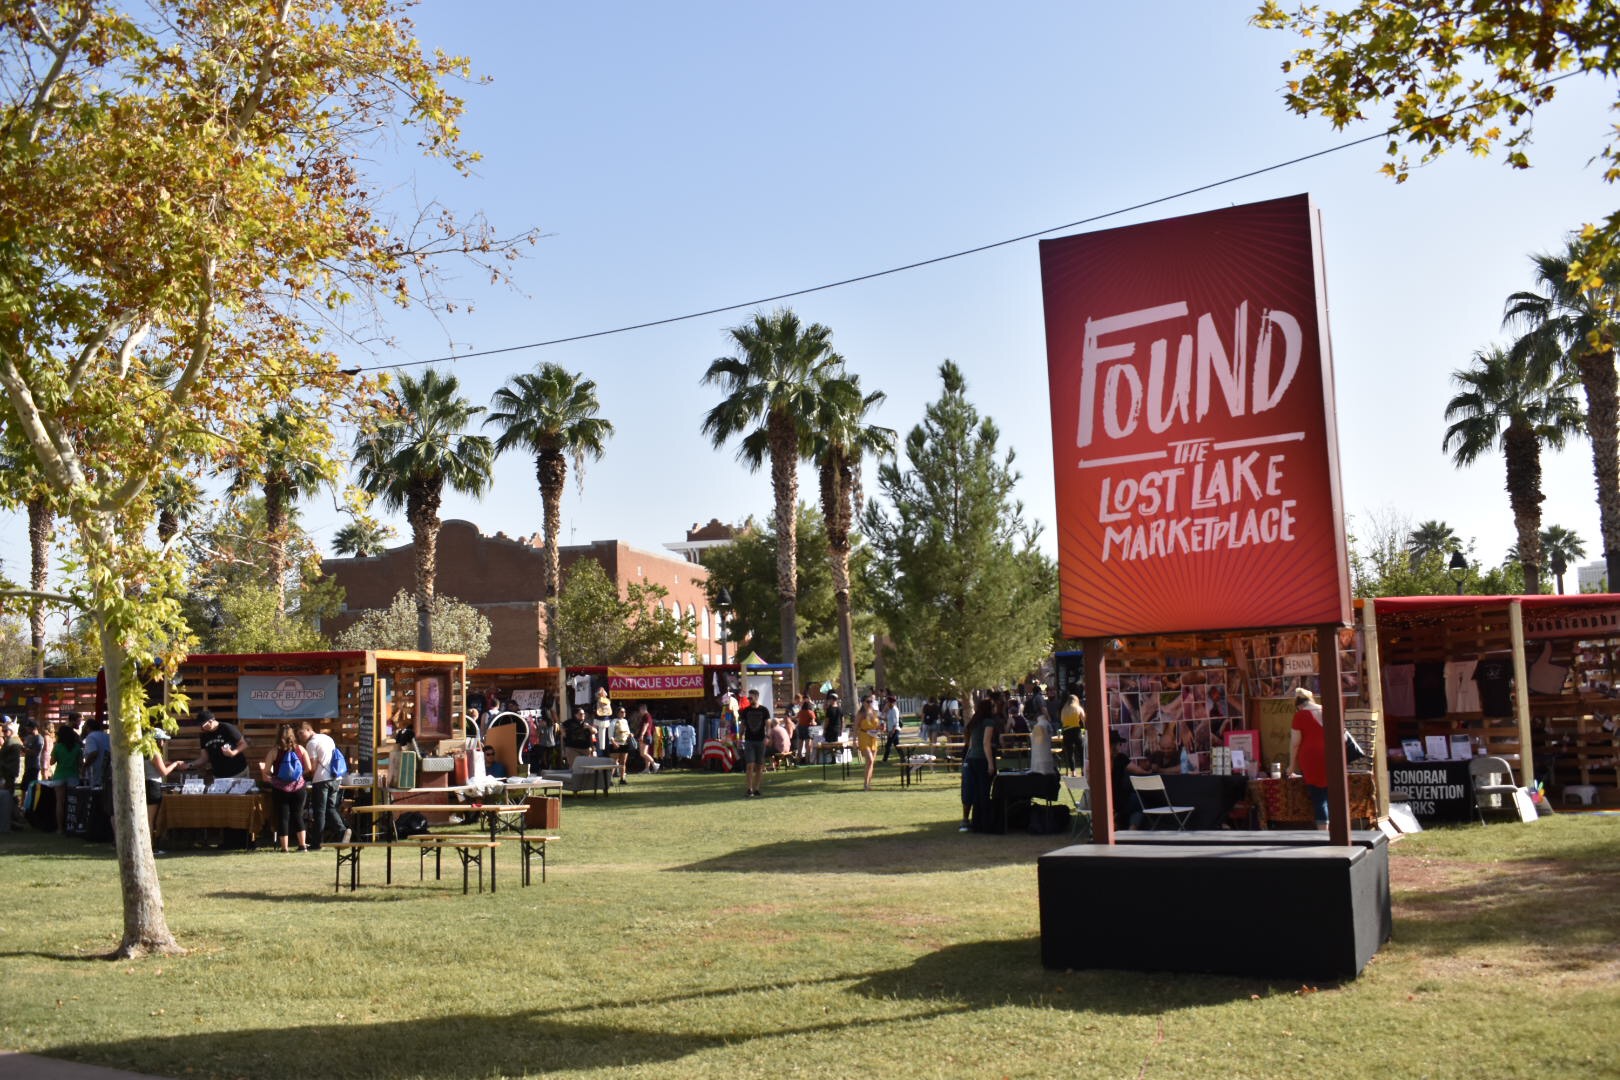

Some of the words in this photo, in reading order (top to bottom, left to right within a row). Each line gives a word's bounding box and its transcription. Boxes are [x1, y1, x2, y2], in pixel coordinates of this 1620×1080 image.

[1077, 300, 1302, 448] FOUND
[1168, 437, 1215, 464] THE
[1099, 468, 1184, 523] LOST
[1191, 451, 1285, 509] LAKE
[1102, 500, 1296, 562] MARKETPLACE
[1285, 659, 1313, 671] HENNA
[610, 678, 662, 689] ANTIQUE
[664, 676, 702, 687] SUGAR
[252, 689, 269, 699] JAR
[271, 689, 283, 699] OF
[285, 689, 325, 699] BUTTONS
[1393, 769, 1447, 784] SONORAN
